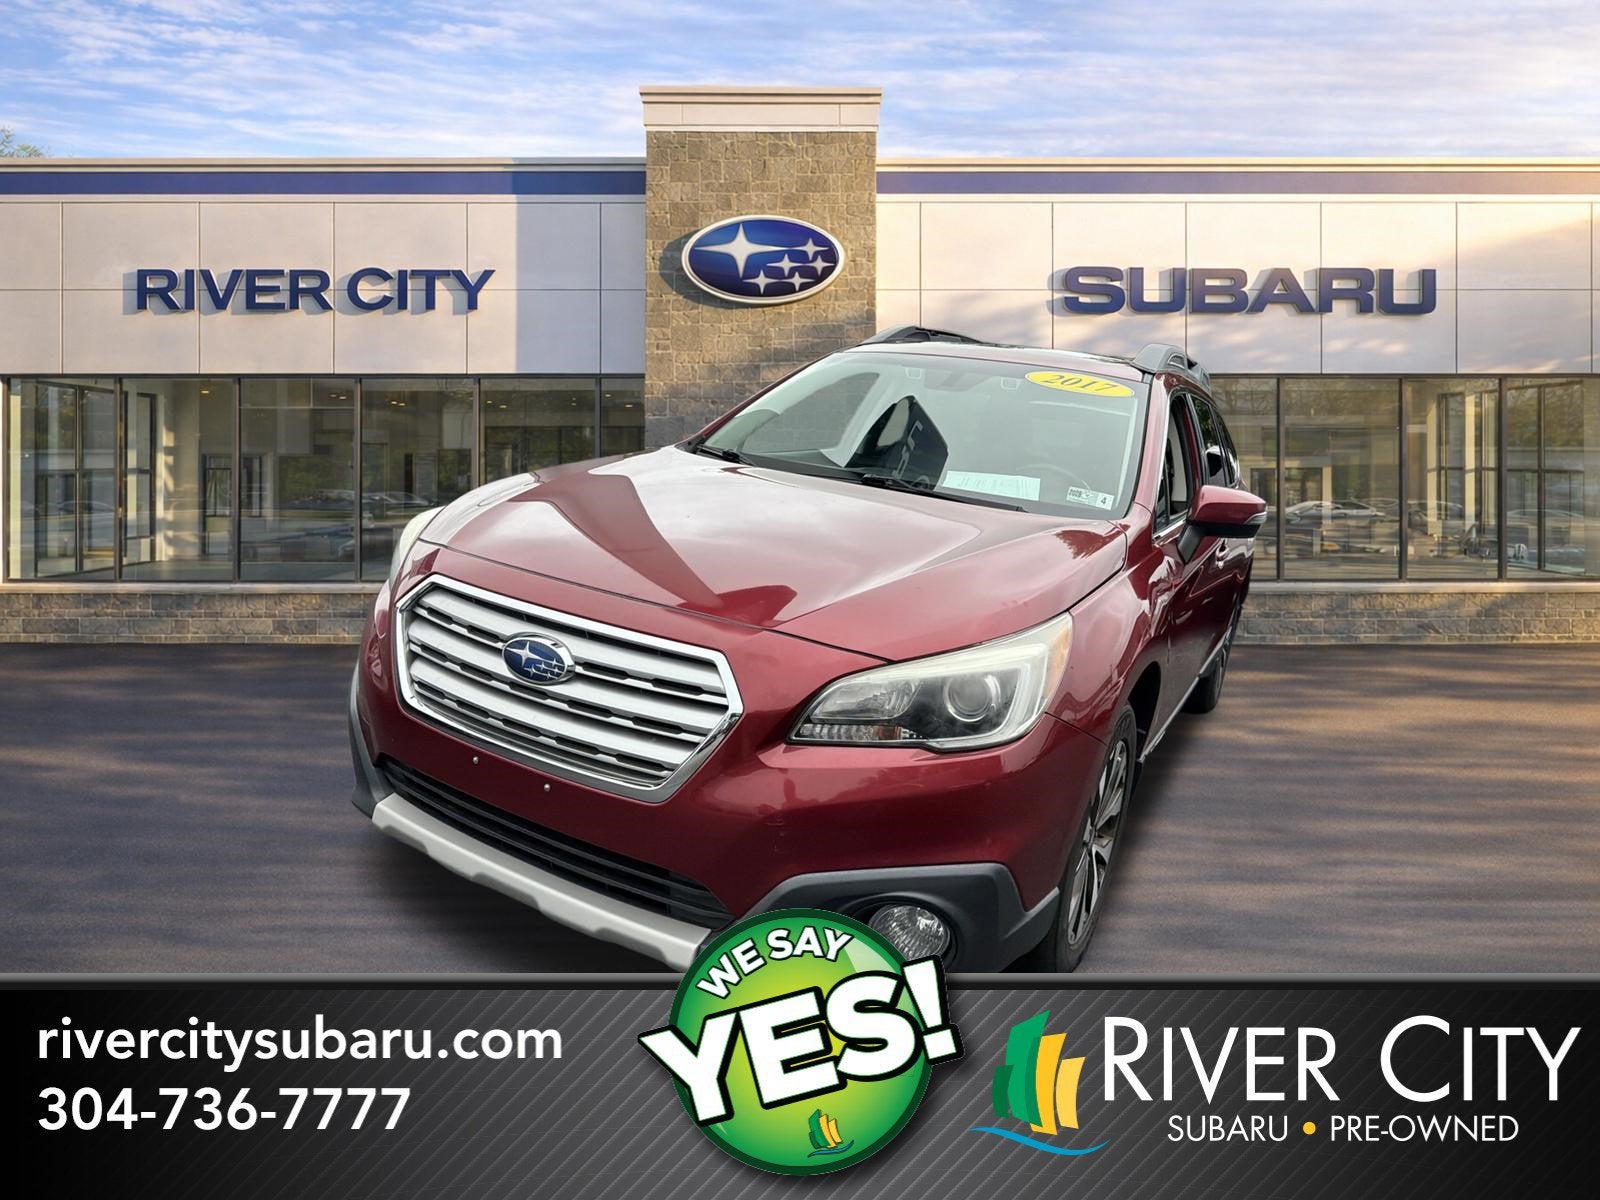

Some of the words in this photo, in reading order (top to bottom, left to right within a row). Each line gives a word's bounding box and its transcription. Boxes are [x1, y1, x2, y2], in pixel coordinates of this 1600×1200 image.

[136, 268, 333, 312] RIVER
[347, 267, 496, 312] CITY
[1063, 266, 1437, 315] SUBARU
[1044, 374, 1117, 393] 2017
